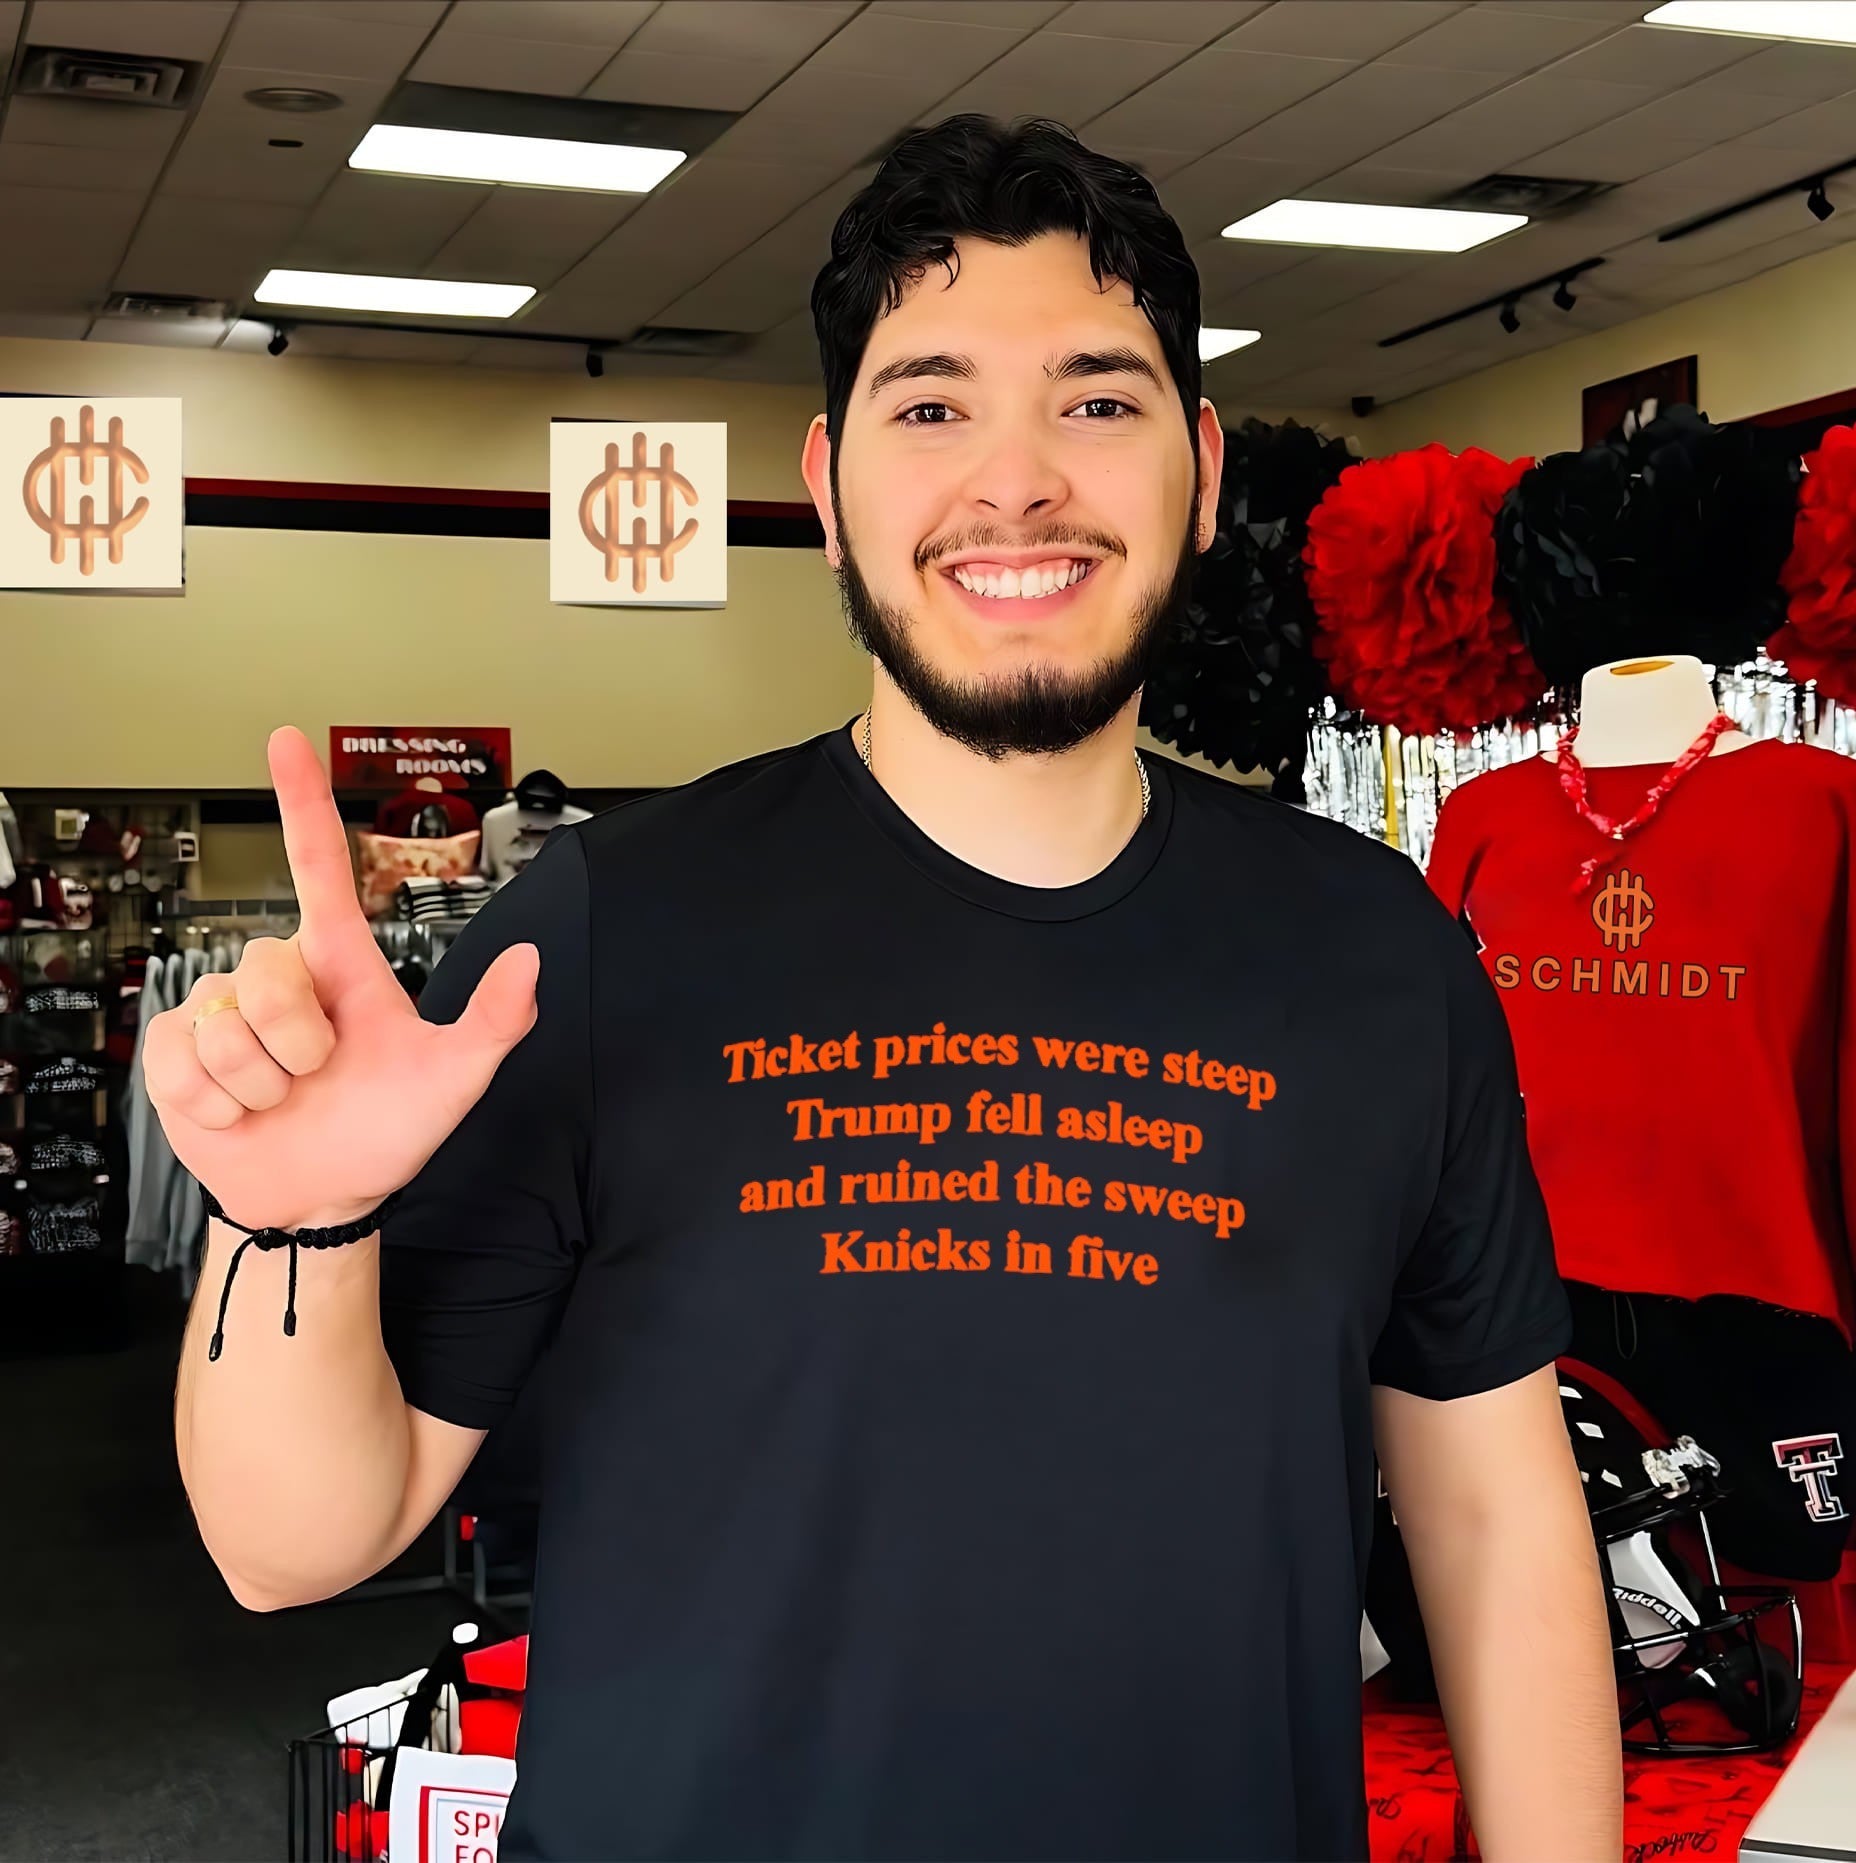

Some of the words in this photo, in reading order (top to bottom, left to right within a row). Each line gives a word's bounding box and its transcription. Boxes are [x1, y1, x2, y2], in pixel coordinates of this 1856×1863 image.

[342, 737, 466, 754] DRESSING
[396, 758, 487, 775] ROOMS
[1494, 954, 1747, 1000] SCHMIDT
[723, 1031, 860, 1083] Ticket
[873, 1023, 1019, 1079] prices
[1033, 1036, 1150, 1078] were
[1163, 1050, 1276, 1110] steep
[787, 1098, 951, 1144] Trump
[966, 1090, 1042, 1136] fell
[1057, 1101, 1203, 1164] asleep
[739, 1166, 825, 1212] and
[840, 1160, 1000, 1204] ruined
[1014, 1162, 1092, 1207] the
[1104, 1181, 1246, 1239] sweep
[820, 1228, 991, 1274] Knicks
[1005, 1230, 1053, 1274] in
[1068, 1235, 1159, 1285] five
